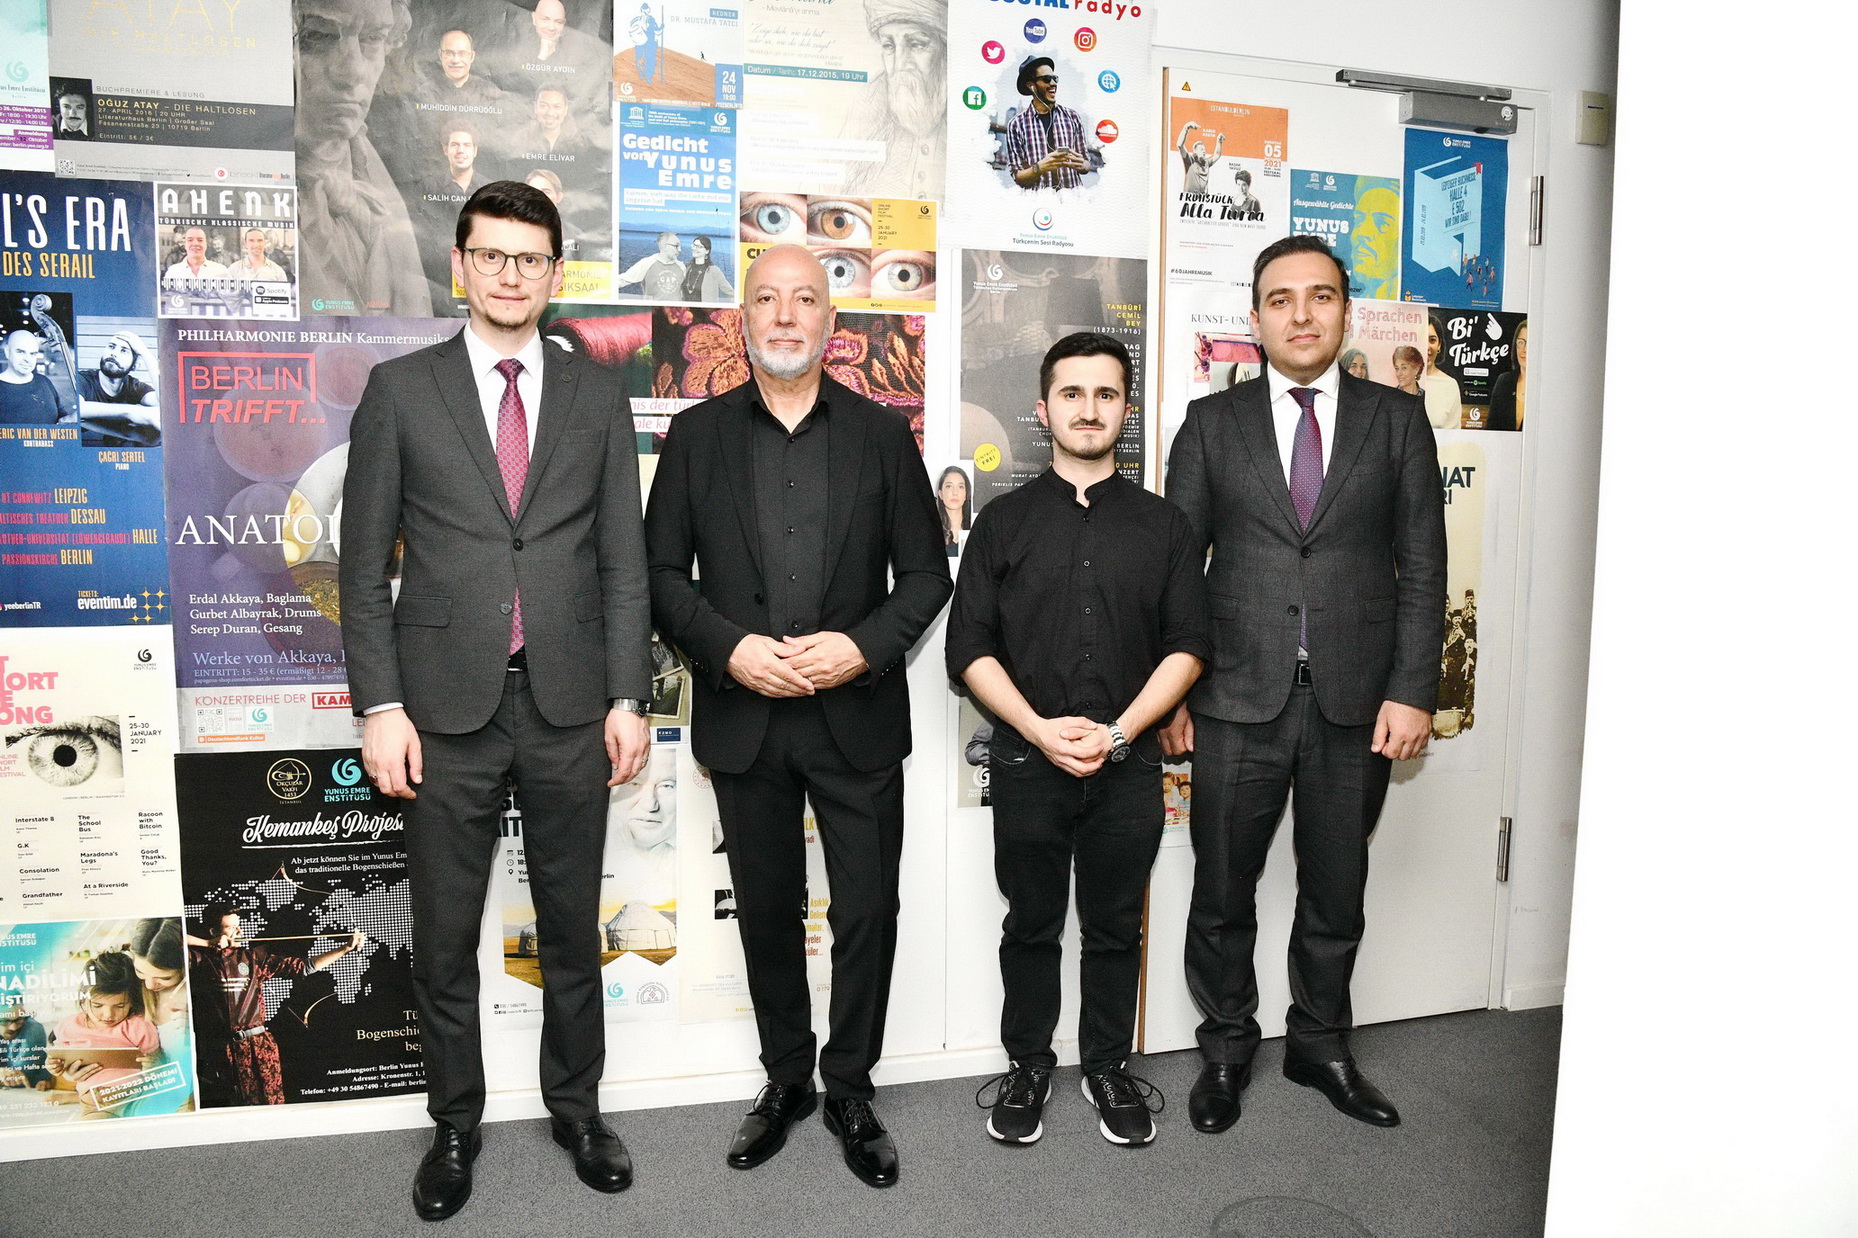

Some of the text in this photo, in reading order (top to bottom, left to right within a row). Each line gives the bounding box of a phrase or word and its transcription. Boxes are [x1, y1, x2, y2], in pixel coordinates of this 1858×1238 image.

[684, 17, 717, 26] MUSTAFA
[526, 63, 576, 74] ÖZGÜR AYDIN
[747, 66, 771, 74] Datum
[797, 69, 839, 79] 17.12.2015,
[851, 73, 864, 81] Uhr
[722, 71, 736, 84] 24
[96, 85, 205, 99] BUCHPREMIERE LESUNG
[722, 85, 736, 94] NOV
[98, 98, 257, 116] OĞUZ ATAY DIE HALTLOSEN
[98, 114, 145, 122] Literaturhaus
[623, 134, 709, 154] Gedicht
[1264, 144, 1282, 158] 05
[526, 153, 575, 162] EMRE ELİVAR
[623, 151, 647, 161] von
[644, 151, 732, 173] Yunus
[1264, 159, 1282, 168] 2021
[658, 169, 732, 190] Emre
[427, 193, 450, 202] SALİH
[1449, 188, 1463, 202] HALLE
[161, 188, 291, 218] AHENK
[1180, 202, 1267, 222] Alla Turca
[3, 193, 132, 251] L'S ERA
[159, 217, 207, 226] TÜRKISCHE
[211, 219, 262, 228] KLASSISCHE
[1292, 216, 1350, 234] YUNUS
[1052, 240, 1074, 248] Radyosu
[3, 251, 96, 279] DES SERAIL
[1170, 268, 1213, 276] #60JAHREMUSIK
[266, 287, 288, 296] Spotify
[1357, 306, 1422, 325] Sprachen
[178, 329, 353, 344] PHILHARMONIE BERLIN
[1093, 326, 1141, 335] (1873-1916)
[1358, 325, 1418, 343] Märchen
[1449, 341, 1510, 367] Türkçe
[191, 366, 303, 391] BERLIN
[191, 399, 327, 424] TRIFFT...
[649, 400, 669, 411] der
[17, 428, 78, 440] VAN DER WESTEN
[121, 451, 146, 463] SERTEL
[54, 488, 88, 504] LEIPZIG
[70, 508, 106, 524] DESSAU
[132, 528, 158, 544] HALLE
[2, 549, 93, 565] PASSIONSKIRCHE BERLIN
[77, 594, 138, 610] eventim.de
[189, 593, 312, 606] Erdal Akkaya, Baglama
[190, 607, 322, 622] Gurbet Albayrak, Drums
[190, 623, 303, 637] Serep Duran, Gesang
[193, 650, 337, 667] Werke von Akkaya,
[194, 668, 240, 677] EINTRITT:
[242, 667, 251, 676] 15
[258, 667, 268, 676] 35
[276, 666, 315, 677] (ermäßigt
[195, 694, 281, 706] KONZERTREIHE
[283, 693, 306, 703] DER
[324, 786, 371, 796] YUNUS EMRE
[324, 793, 371, 803] ENSTİTÜSÜ
[242, 811, 340, 843] Kemankeş
[291, 852, 394, 867] Ab jetzt können Sie im Yunus
[19, 867, 60, 875] Consolation
[295, 861, 405, 874] das traditionelle Bogenschießen
[22, 891, 63, 899] Grandfather
[20, 960, 35, 974] içi
[326, 1066, 378, 1076] Anmeldungsort:
[378, 1063, 399, 1071] Berlin
[352, 1071, 414, 1083] Adresse: Kronenstr.
[99, 1078, 144, 1096] 2021-2022
[300, 1087, 326, 1096] Telefon:
[349, 1083, 379, 1092] 54867490
[384, 1081, 407, 1089] E-mail:
[102, 1087, 143, 1103] KAYITLARI
